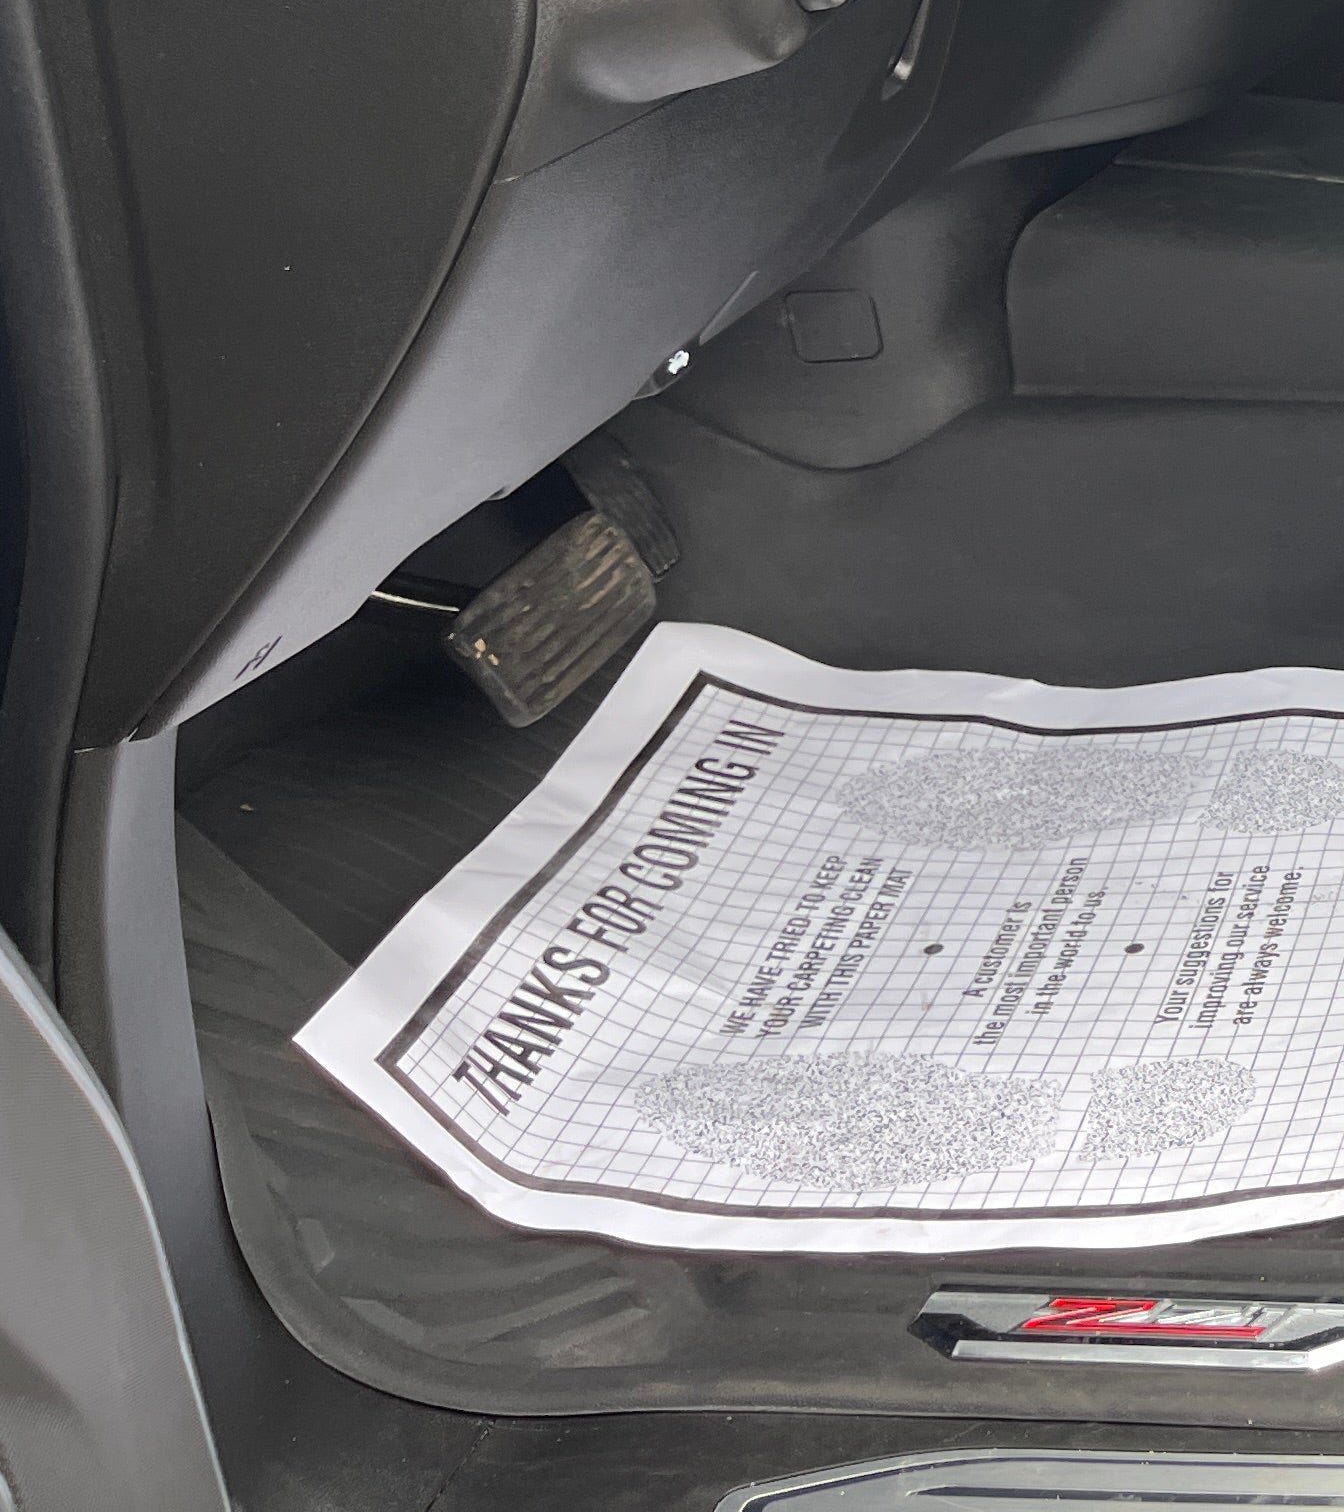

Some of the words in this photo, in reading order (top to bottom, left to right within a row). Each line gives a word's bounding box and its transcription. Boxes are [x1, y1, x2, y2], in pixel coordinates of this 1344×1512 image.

[809, 854, 848, 890] KEEP
[1051, 856, 1089, 906] person
[1236, 864, 1271, 920] service
[452, 946, 611, 1117] THANKS
[567, 884, 665, 953] FOR
[619, 757, 760, 892] COMING
[714, 719, 786, 756] IN
[795, 893, 826, 911] TO
[1071, 911, 1097, 927] to
[1264, 866, 1305, 939] welcome.
[755, 996, 804, 1039] YOUR
[787, 904, 856, 992] CARPETING
[839, 856, 884, 902] CLEAN
[766, 917, 812, 962] TRIED
[799, 991, 843, 1029] WITH
[824, 953, 866, 989] THIS
[847, 901, 896, 949] PAPER
[877, 866, 914, 899] MAT
[974, 916, 1024, 985] customer
[1007, 908, 1065, 979] important
[1053, 929, 1089, 969] world
[1153, 989, 1190, 1025] Your
[1175, 896, 1226, 986] suggestions
[1207, 871, 1235, 893] for
[1226, 923, 1251, 948] our
[738, 965, 784, 1008] HAVE
[1036, 974, 1068, 997] the
[1188, 951, 1245, 1029] improving
[1240, 942, 1281, 996] always
[962, 988, 989, 998] A
[992, 981, 1030, 1017] most
[1024, 1000, 1054, 1015] in
[1232, 999, 1258, 1025] are
[719, 1009, 756, 1035] WE
[973, 1020, 1005, 1045] the
